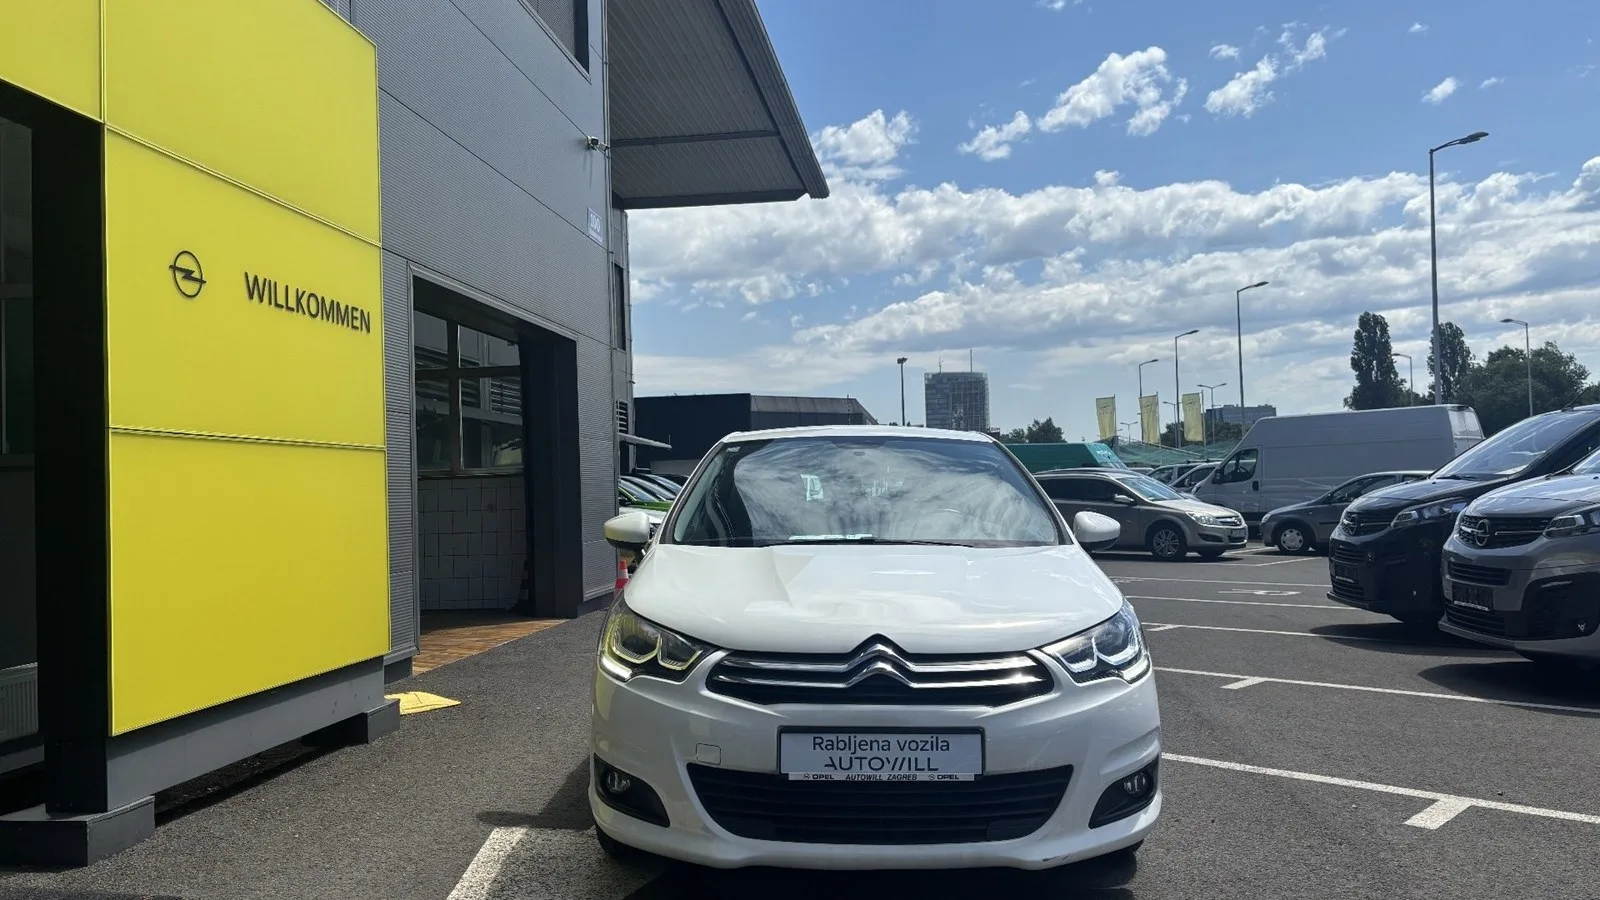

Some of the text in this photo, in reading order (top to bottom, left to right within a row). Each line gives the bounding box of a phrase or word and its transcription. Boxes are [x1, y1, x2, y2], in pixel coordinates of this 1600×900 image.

[244, 271, 371, 334] WILLKOMMEN
[812, 735, 950, 755] Rabljena vozila
[824, 756, 939, 771] AUTOWILL
